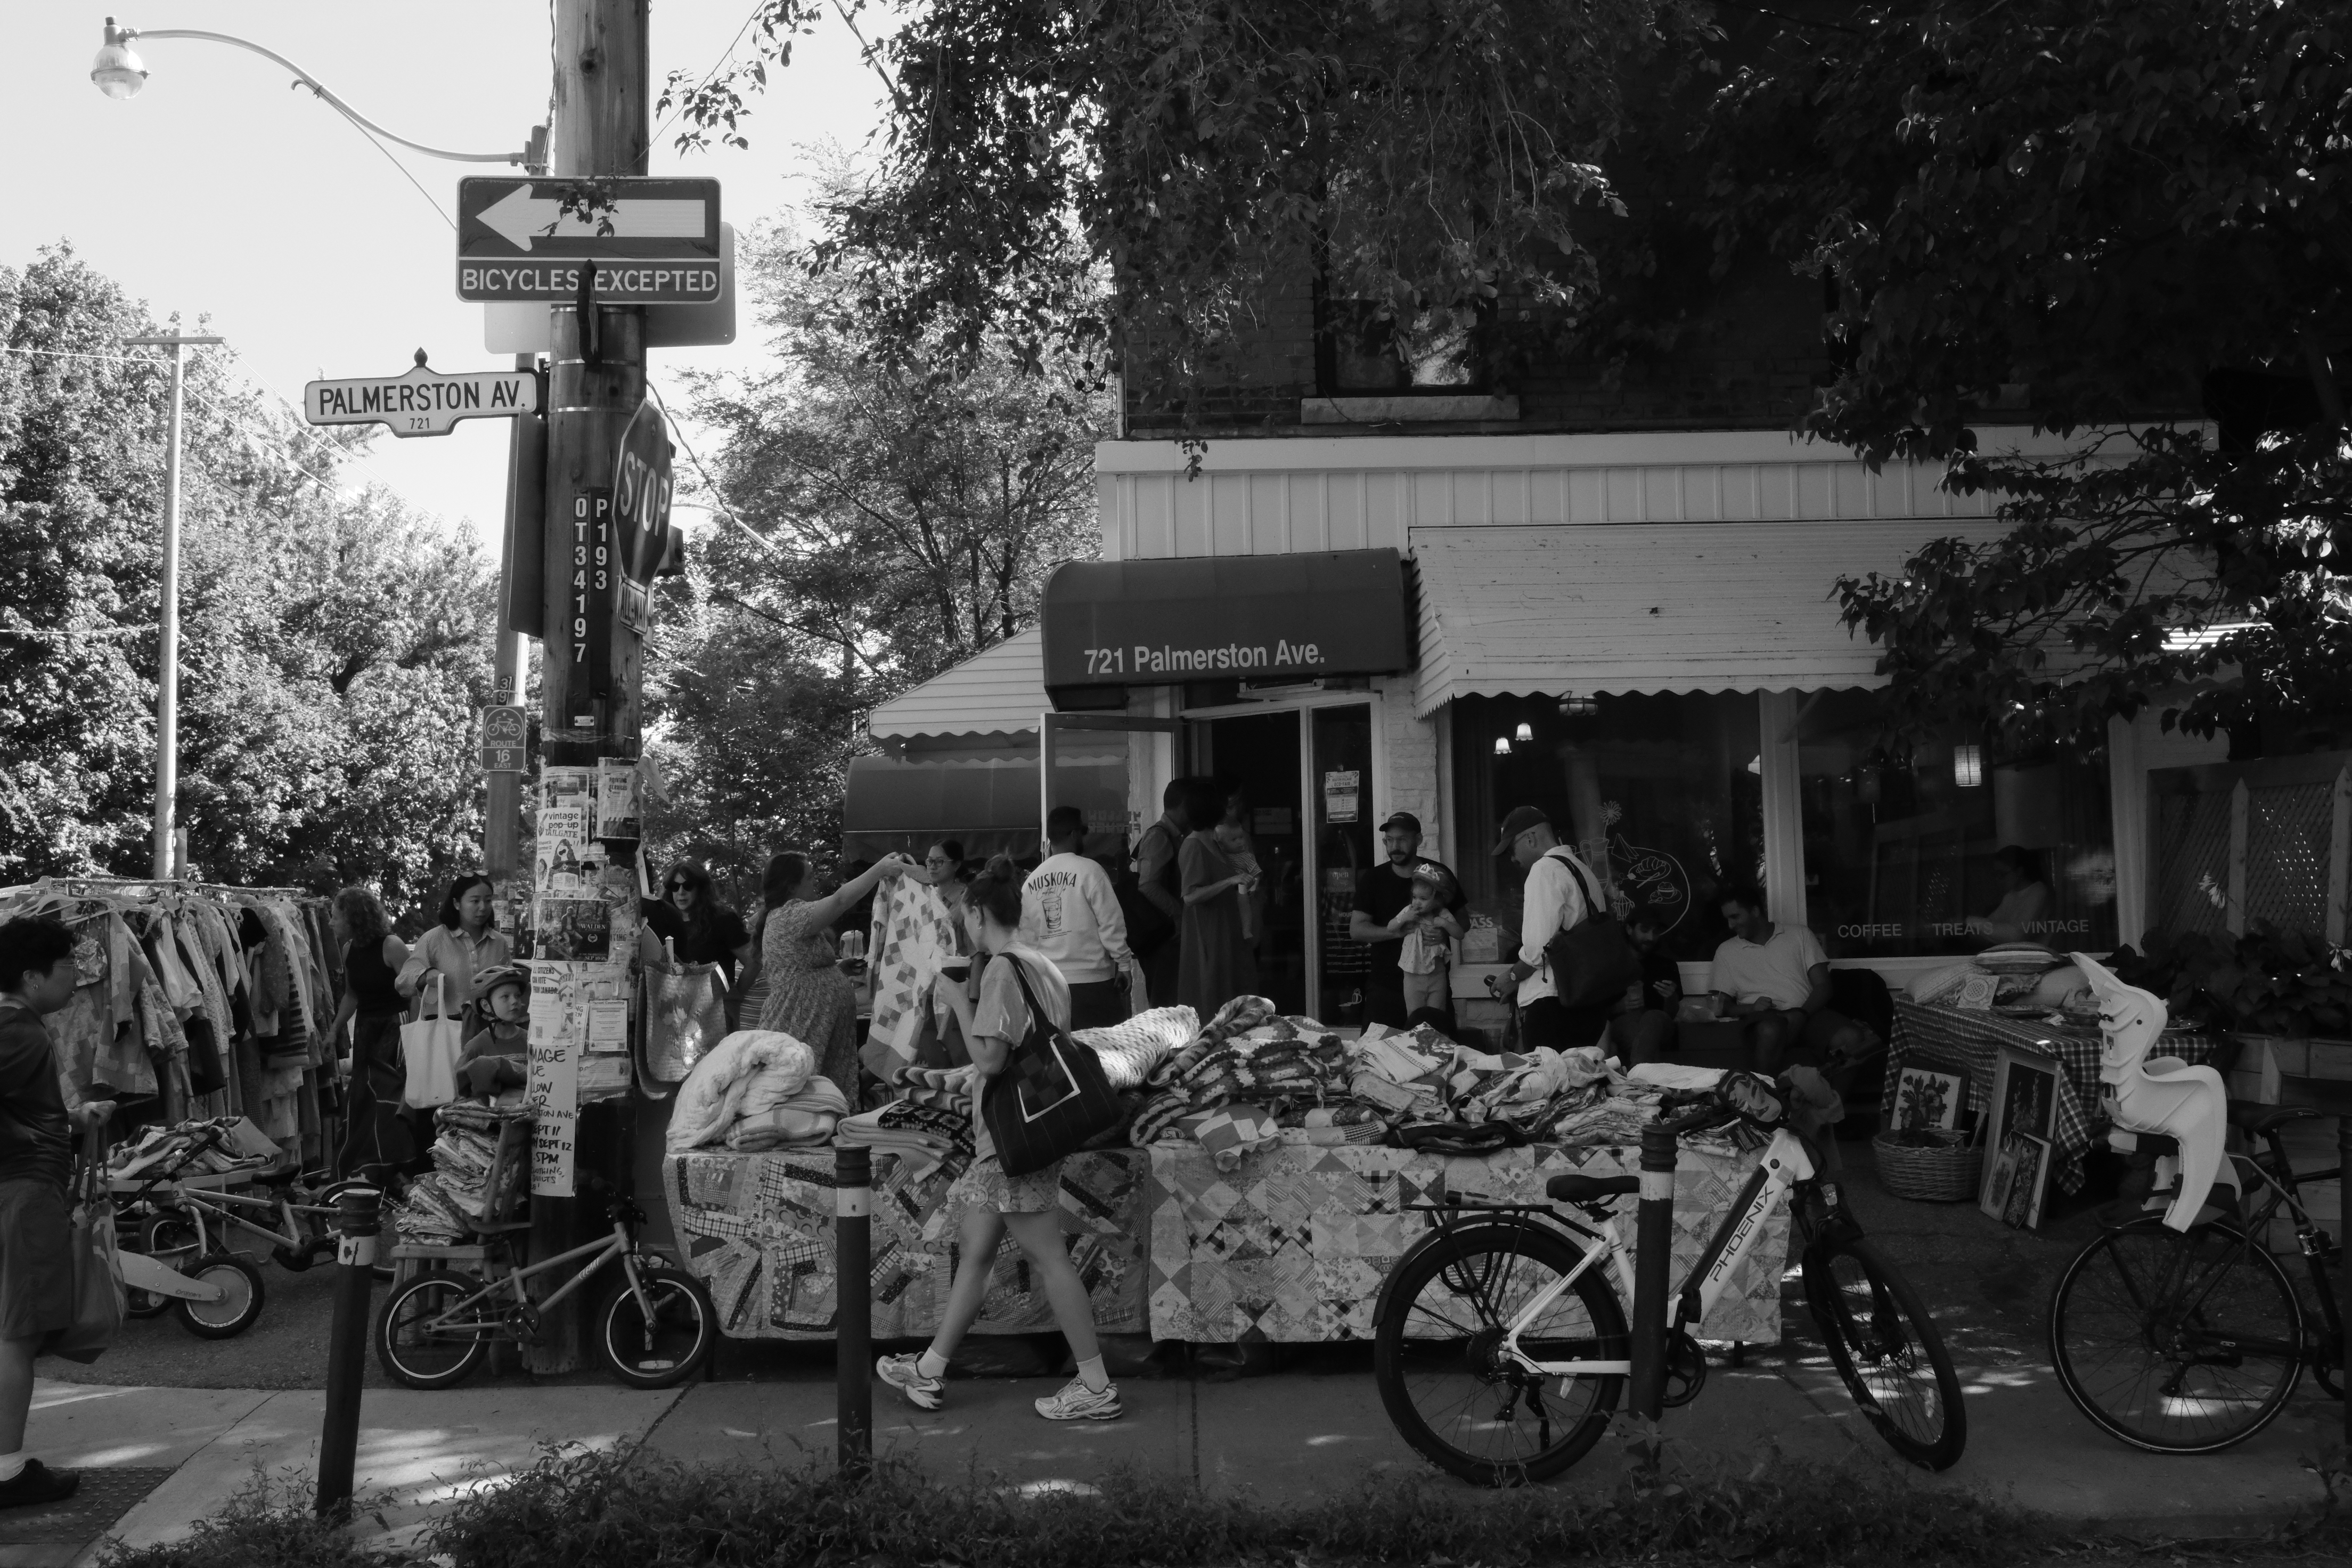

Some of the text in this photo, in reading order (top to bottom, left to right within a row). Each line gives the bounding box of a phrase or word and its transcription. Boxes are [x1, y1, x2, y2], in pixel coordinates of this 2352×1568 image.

[462, 268, 717, 292] BICYCLES EXCEPTED
[319, 380, 526, 415] PALMERSTON AV.
[409, 417, 430, 430] 721
[620, 451, 669, 537] STOP
[594, 498, 608, 590] P193
[619, 585, 647, 628] ALL-WAY
[1084, 639, 1326, 675] 721 Palmerston Ave.
[495, 749, 510, 763] 16
[549, 812, 578, 821] vintage
[545, 829, 578, 838] TAILGATE
[1028, 871, 1077, 895] MUSKOKA
[1333, 872, 1349, 880] open
[1469, 917, 1493, 929] ASS
[1838, 923, 1902, 938] COFFEE
[1933, 921, 1994, 936] TREATS
[2021, 919, 2089, 934] VINTAGE
[532, 1081, 553, 1093] LOW
[557, 1110, 574, 1119] AVE
[534, 1124, 551, 1135] EPT
[539, 1138, 561, 1149] SEPT
[562, 1142, 572, 1151] 12
[1710, 1185, 1775, 1282] PHOENIX
[578, 1256, 600, 1280] CLEARY
